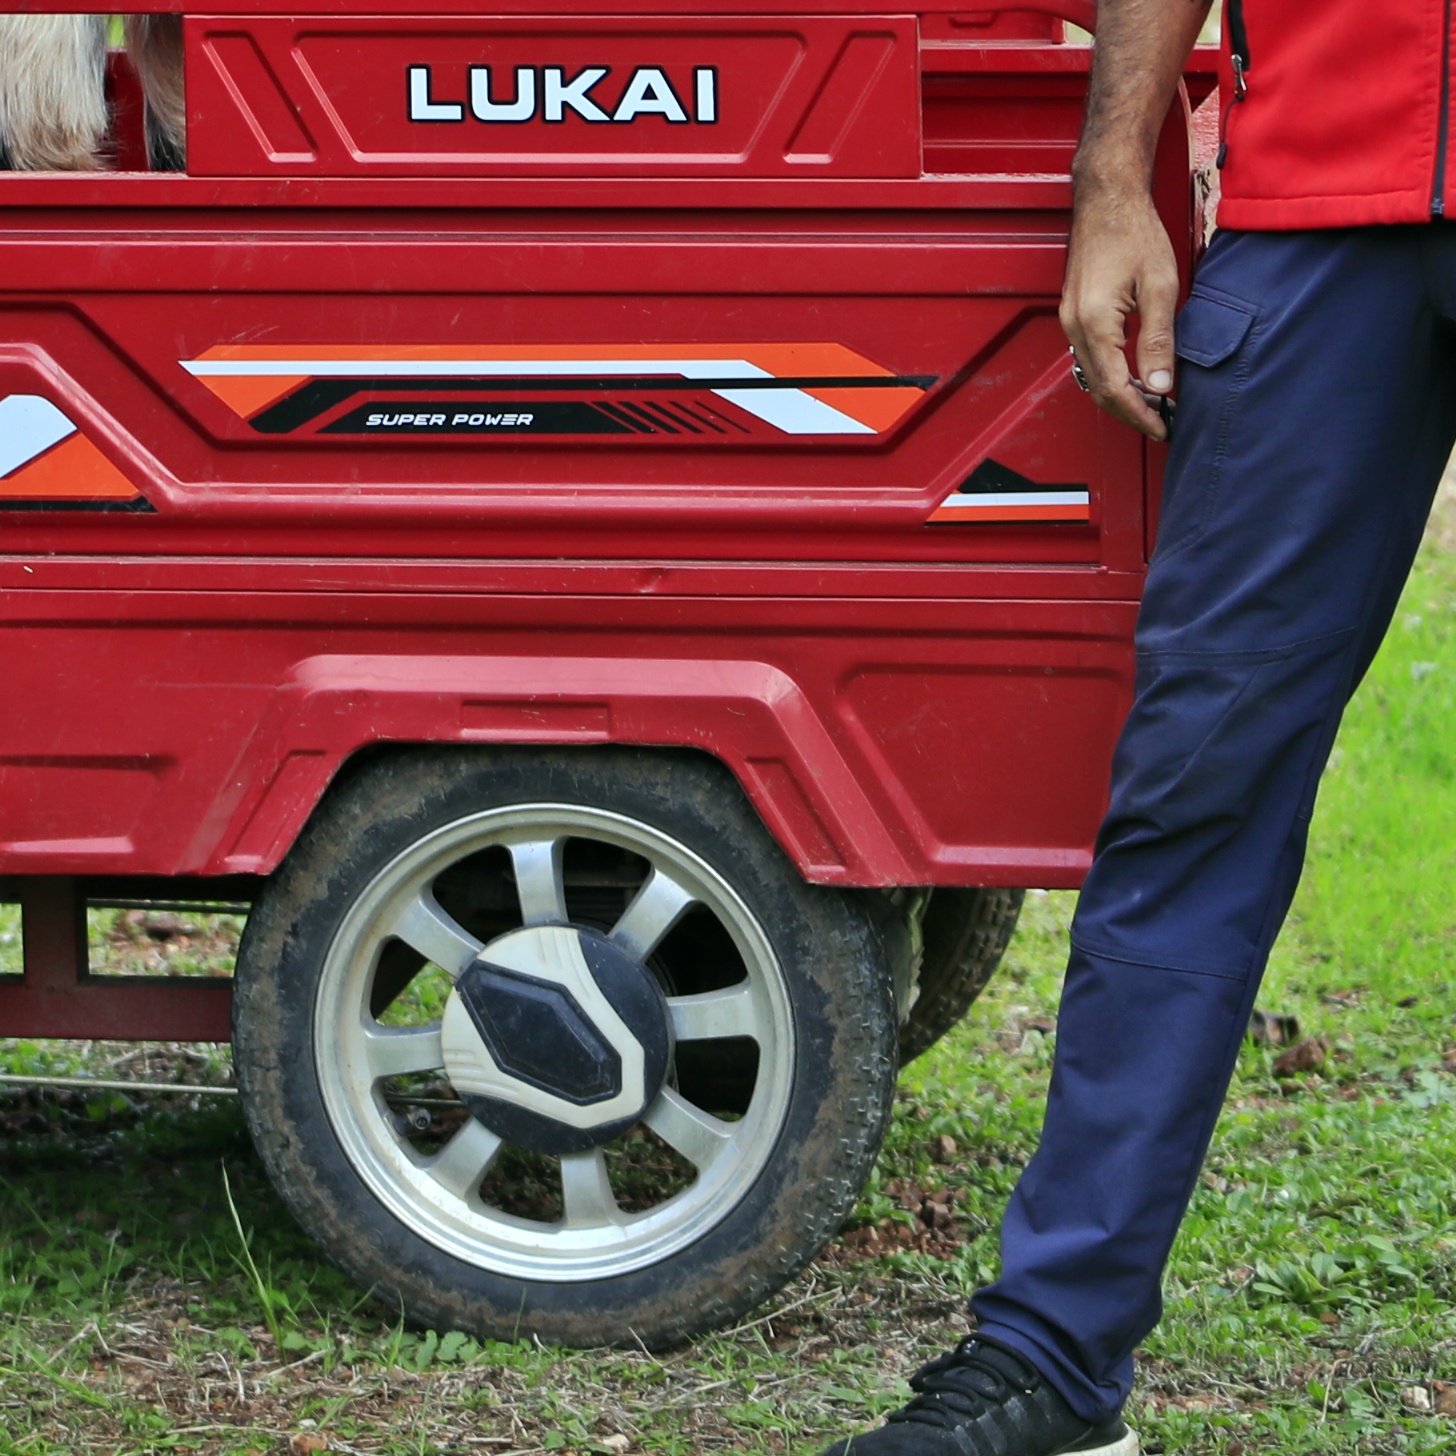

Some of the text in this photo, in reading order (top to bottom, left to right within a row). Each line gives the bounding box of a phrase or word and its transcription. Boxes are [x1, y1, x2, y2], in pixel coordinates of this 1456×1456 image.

[408, 66, 717, 123] LUKAI
[366, 413, 534, 426] SUPER POWER
